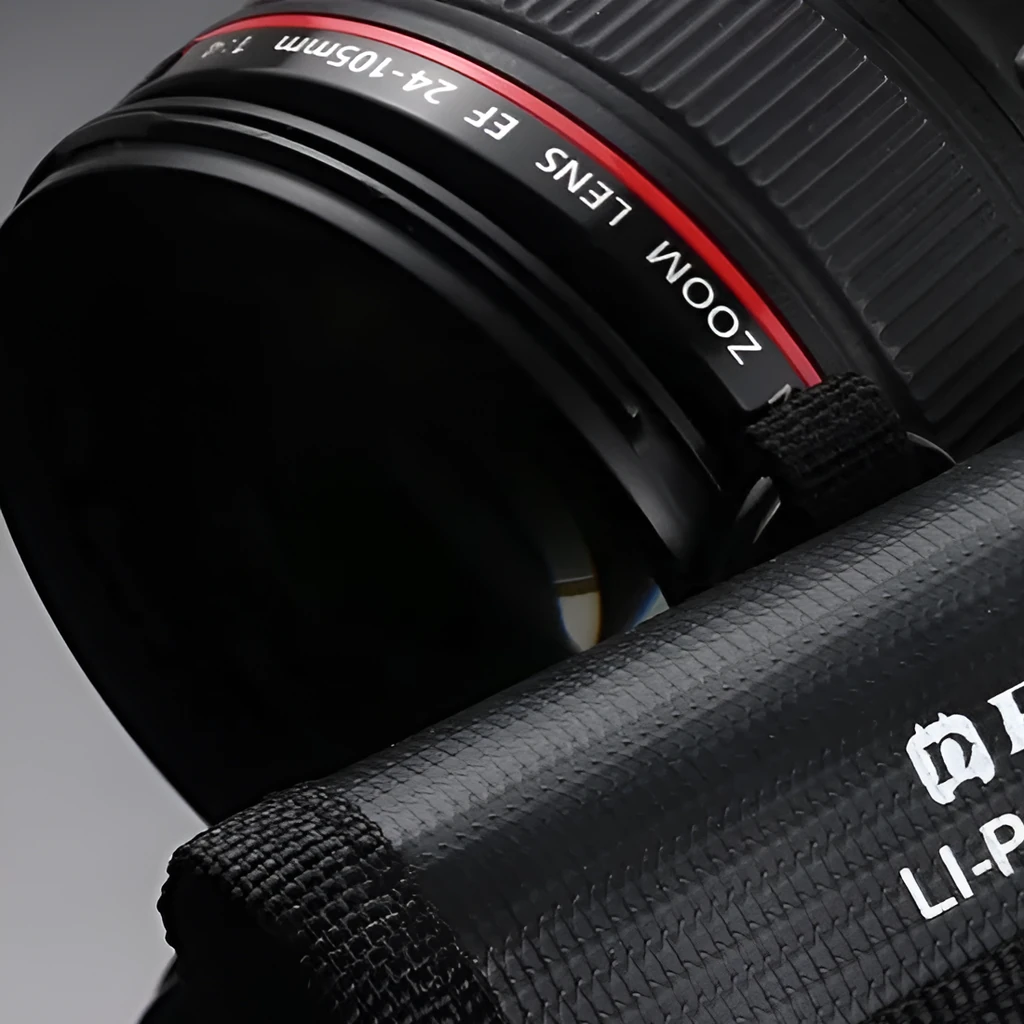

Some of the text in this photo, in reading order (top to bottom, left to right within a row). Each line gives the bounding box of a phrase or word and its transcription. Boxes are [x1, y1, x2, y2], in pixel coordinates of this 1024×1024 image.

[274, 36, 457, 105] 24-105mm
[464, 104, 520, 140] EF
[534, 147, 633, 227] LENS
[646, 240, 763, 366] ZOOM
